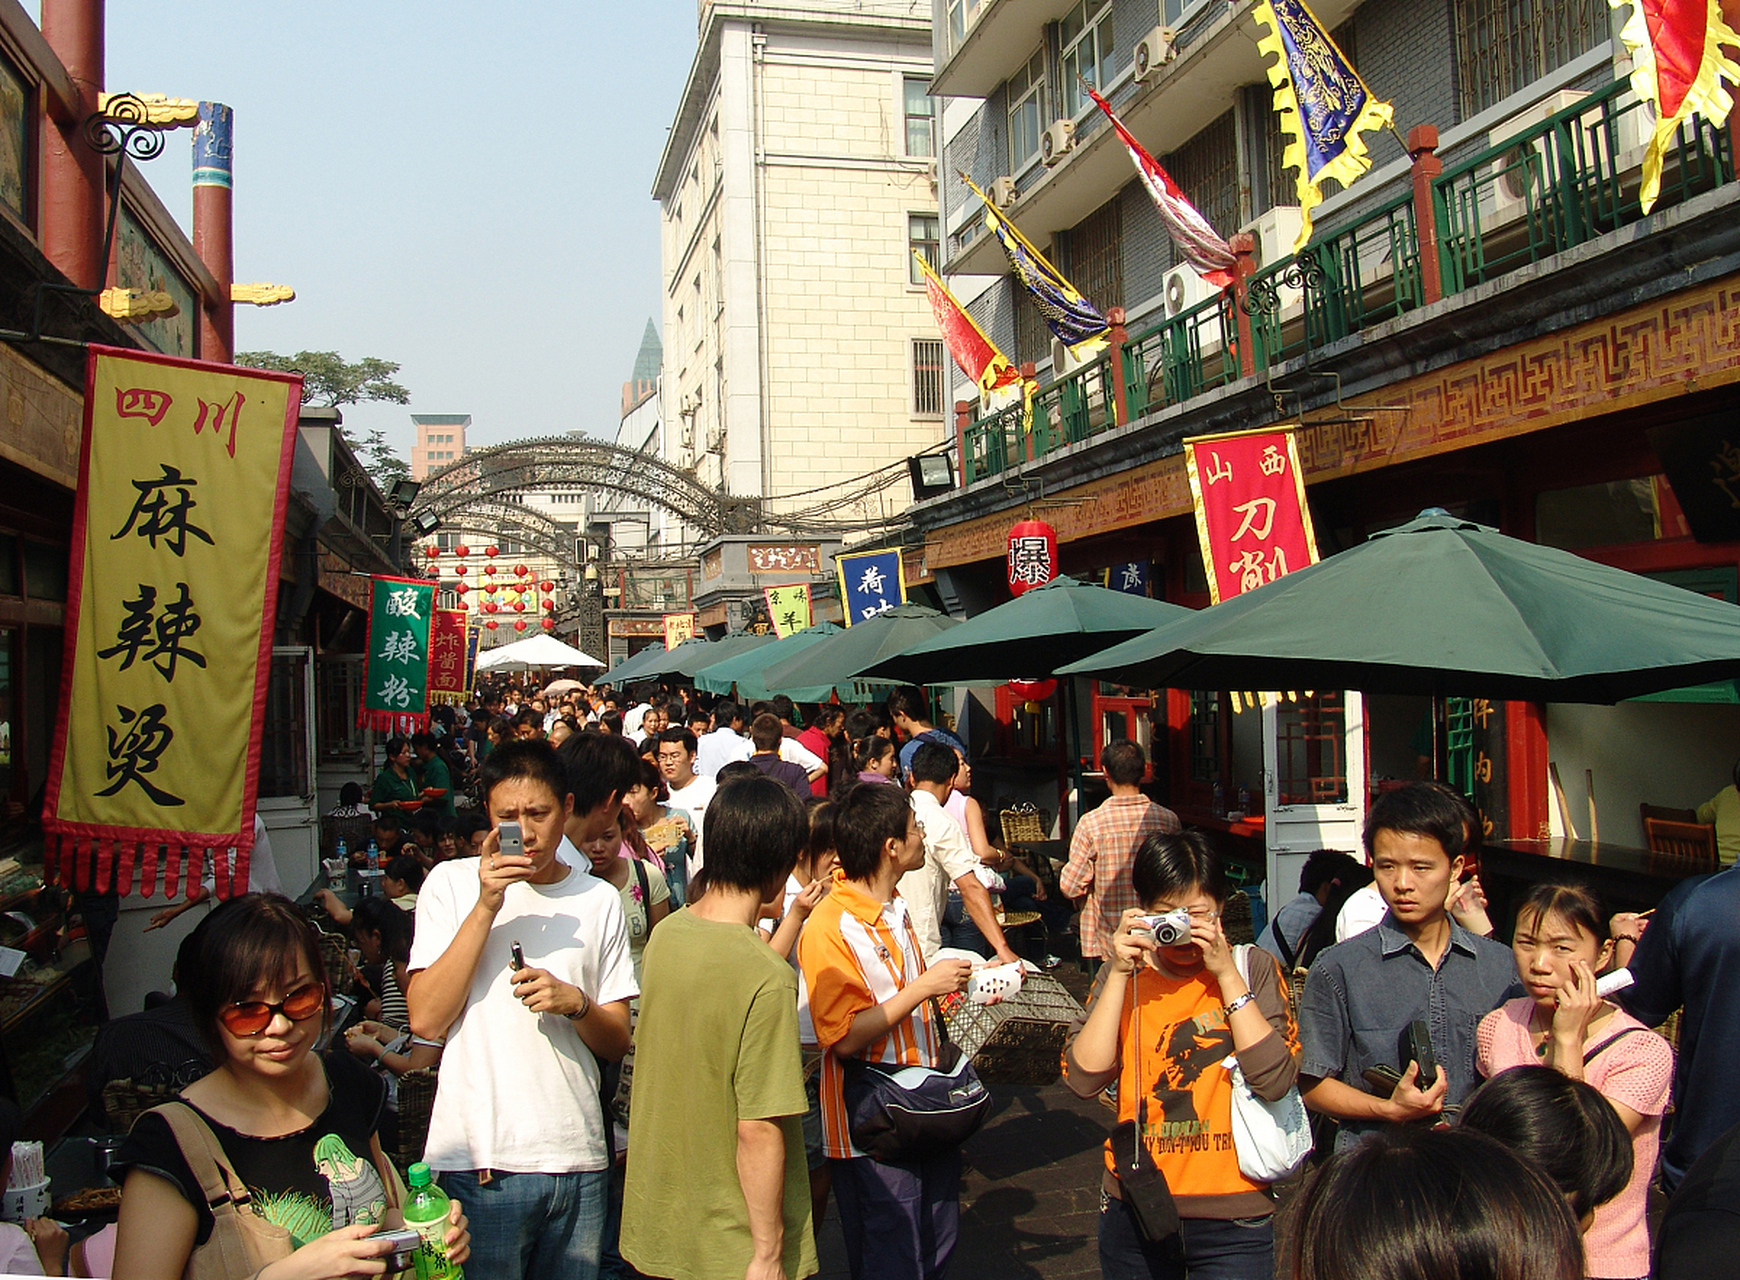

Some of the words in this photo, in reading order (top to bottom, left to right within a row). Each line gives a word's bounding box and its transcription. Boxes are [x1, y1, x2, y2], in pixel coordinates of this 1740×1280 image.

[115, 386, 246, 458] 四川
[1206, 445, 1286, 485] 山西
[1009, 536, 1050, 585] 爆
[1229, 497, 1289, 594] 刀削
[93, 463, 215, 807] 麻辣烫
[377, 587, 421, 708] 酸辣粉
